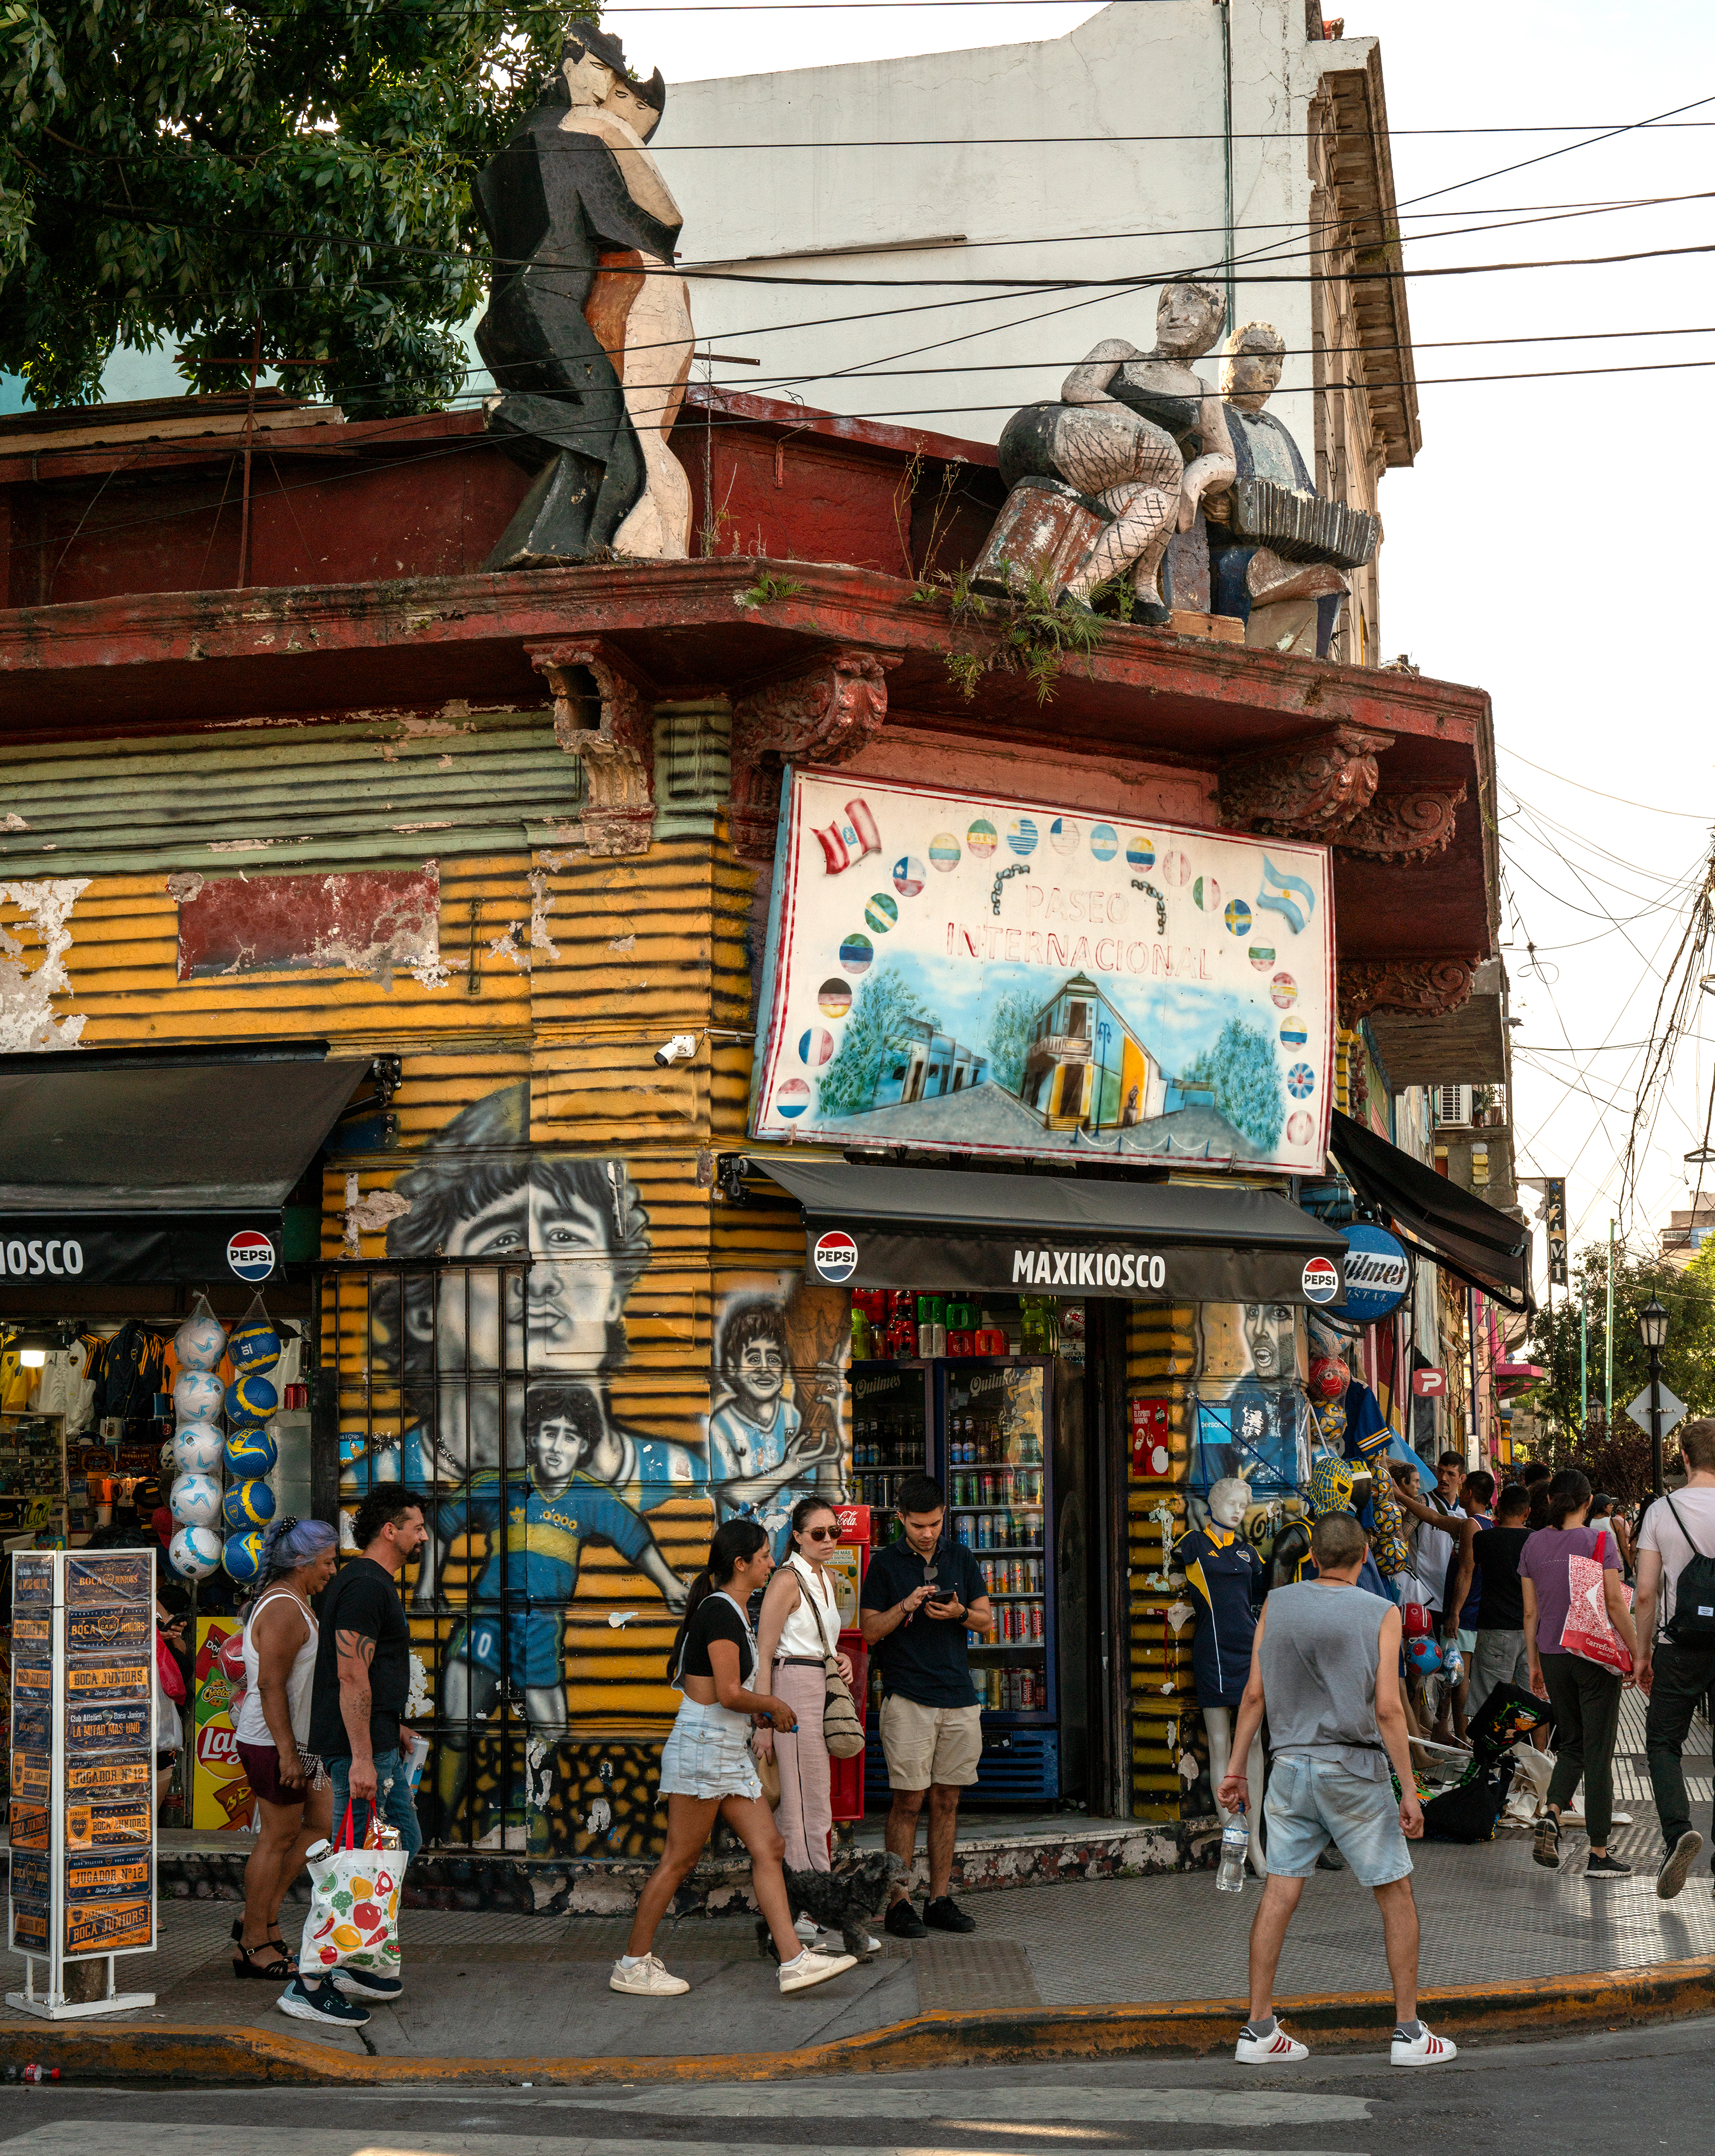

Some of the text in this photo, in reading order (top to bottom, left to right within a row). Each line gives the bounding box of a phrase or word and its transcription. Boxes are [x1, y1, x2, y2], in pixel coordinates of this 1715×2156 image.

[1026, 884, 1130, 924] PASEO
[946, 922, 1213, 981] INTERNACIONAL
[230, 1250, 272, 1262] PEPSI
[817, 1250, 855, 1263] PEPSI
[1012, 1250, 1166, 1288] MAXIKIOSCO
[1304, 1274, 1336, 1286] PEPSI
[241, 1345, 250, 1356] 10
[855, 1374, 901, 1399] Quilmes
[79, 1576, 103, 1586] BOCA
[114, 1575, 138, 1584] JUNIORS
[71, 1624, 96, 1636] BOCA
[119, 1621, 145, 1633] JUNIORS
[1585, 1637, 1616, 1654] Carrefour
[74, 1670, 143, 1686] BOCA JUNIORS
[70, 1711, 146, 1723] Club Atletico Boca Juniors
[73, 1721, 140, 1737] LA MITAD MAS UNO
[73, 1770, 117, 1784] JUGADOR
[93, 1818, 146, 1831] BOCA JUNIORS
[13, 1867, 26, 1879] BOCA
[74, 1869, 117, 1884] JUGADOR
[73, 1923, 98, 1942] BOCA
[102, 1908, 145, 1933] JUNIORS
